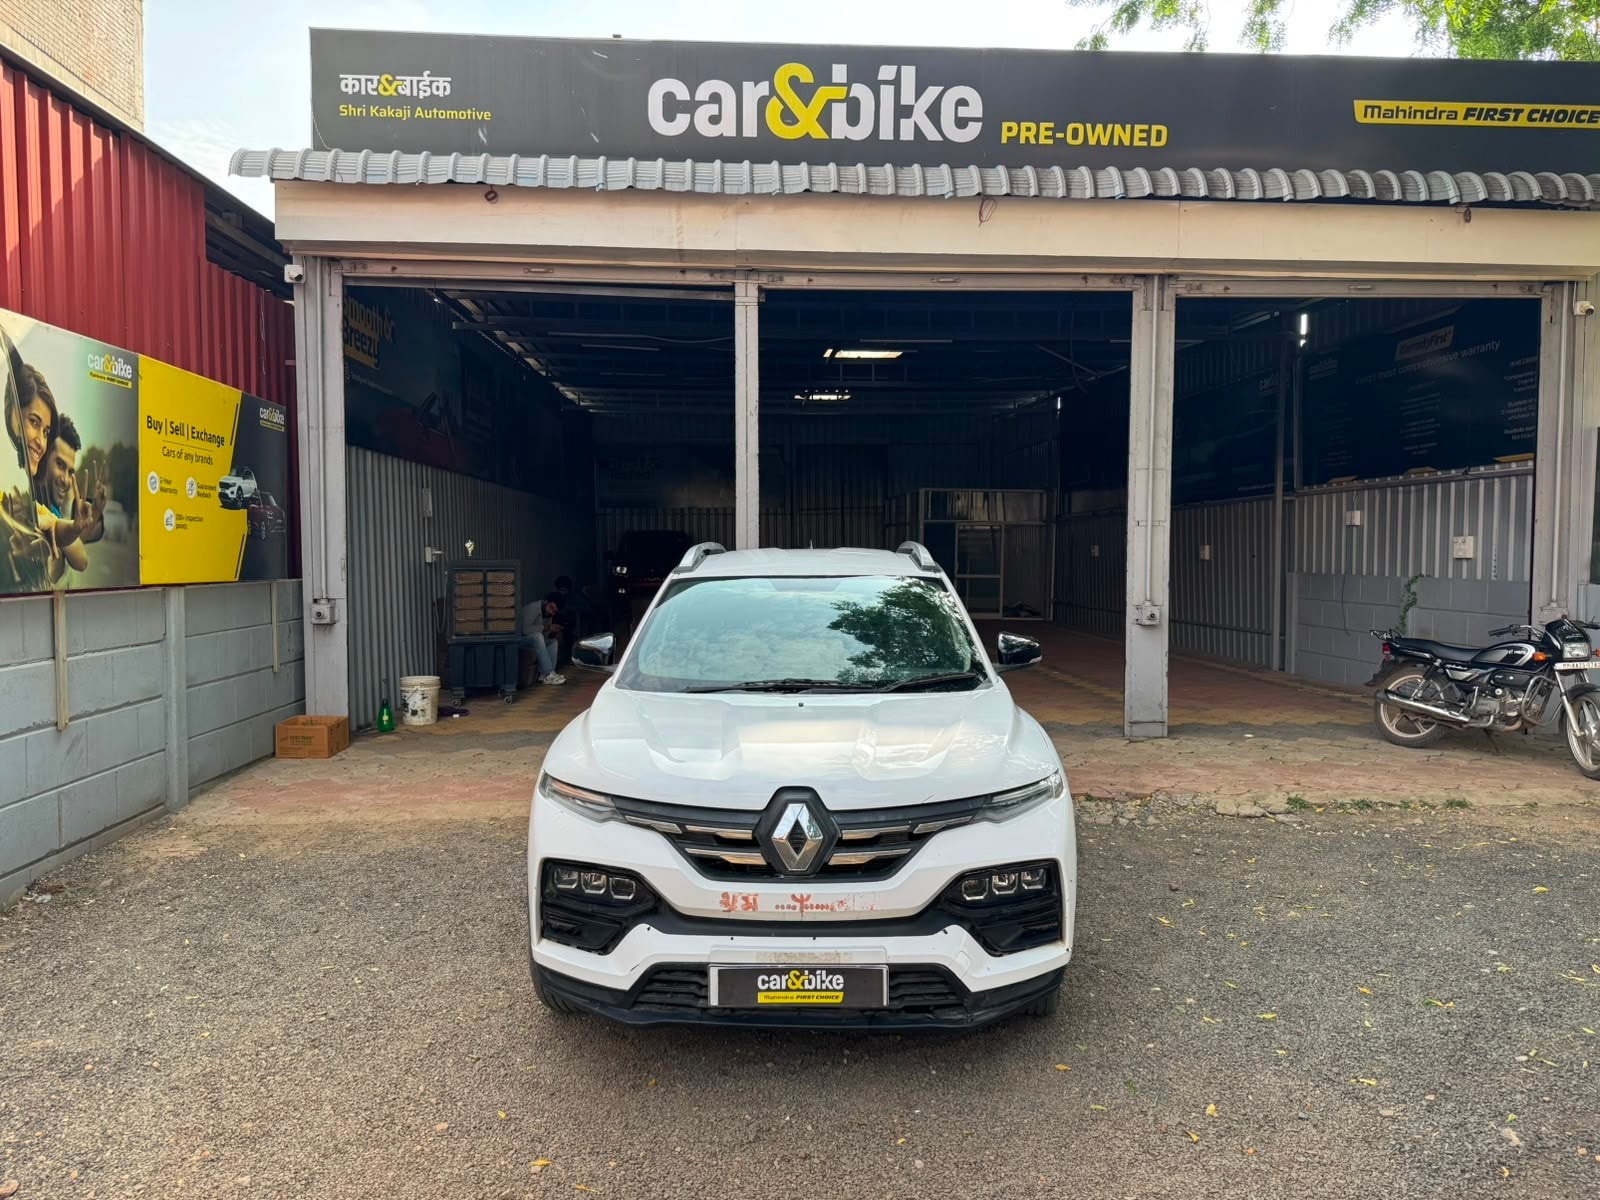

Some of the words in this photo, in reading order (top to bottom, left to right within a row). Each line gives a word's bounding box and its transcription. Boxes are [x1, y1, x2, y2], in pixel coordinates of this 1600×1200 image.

[339, 70, 452, 99] कार&बाईक
[339, 104, 366, 117] Shri
[370, 105, 411, 121] Kakaji
[414, 106, 492, 121] Automotive
[647, 62, 983, 142] car&bike
[1363, 104, 1458, 121] Mahindra
[1463, 107, 1524, 123] FIRST
[1526, 108, 1600, 124] CHOICE
[1000, 121, 1168, 148] PRE-OWNED
[1460, 338, 1502, 359] warranty
[87, 353, 133, 379] car&bike
[146, 415, 163, 434] Buy
[169, 421, 185, 437] Sell
[191, 426, 224, 447] Exchange
[161, 446, 176, 459] Cars
[176, 449, 184, 459] of
[184, 453, 194, 464] any
[195, 452, 214, 465] brands
[757, 969, 844, 990] car&bike
